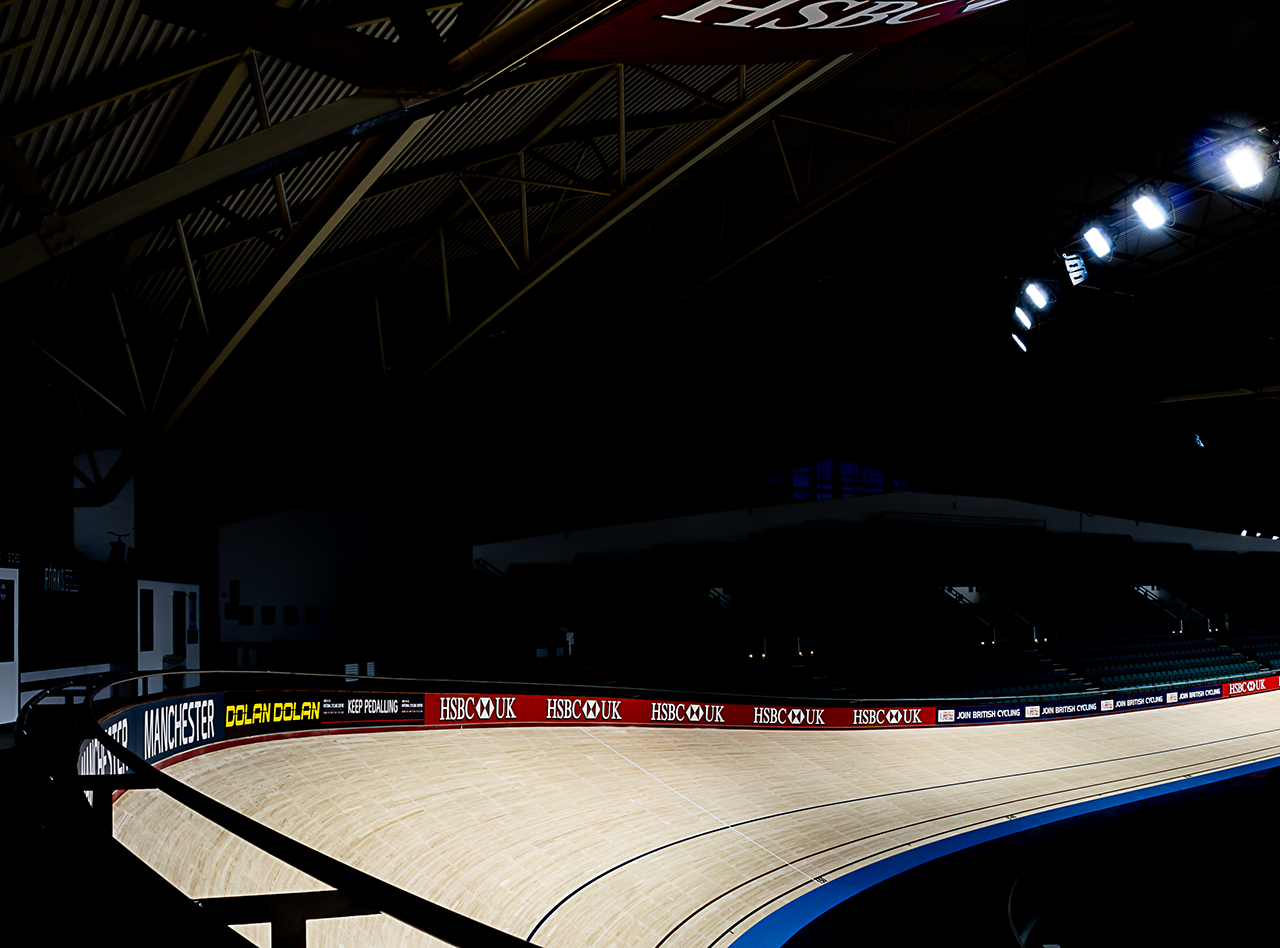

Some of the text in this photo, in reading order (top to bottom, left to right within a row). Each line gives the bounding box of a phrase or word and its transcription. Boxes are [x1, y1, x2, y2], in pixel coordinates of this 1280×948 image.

[1205, 688, 1220, 696] CYCLING
[1229, 679, 1266, 694] HSBC UK
[348, 699, 362, 714] KEEP
[364, 699, 398, 713] PEDALLING
[440, 697, 475, 721] HSBC
[495, 697, 516, 719] UK
[547, 698, 622, 720] HSBC UK
[1055, 705, 1075, 714] BRITISH
[1077, 703, 1096, 712] CYCLING
[1127, 698, 1144, 707] BRITISH
[1146, 696, 1163, 704] CYCLING
[226, 702, 271, 727] DOLAN
[273, 701, 320, 722] DOLAN
[651, 702, 724, 723] HSBC UK
[754, 707, 825, 725] HSBC UK
[853, 709, 885, 725] HSBC
[904, 709, 922, 724] UK
[973, 710, 996, 718] BRITISH
[997, 709, 1020, 717] CYCLING
[144, 700, 214, 759] MANCHESTER
